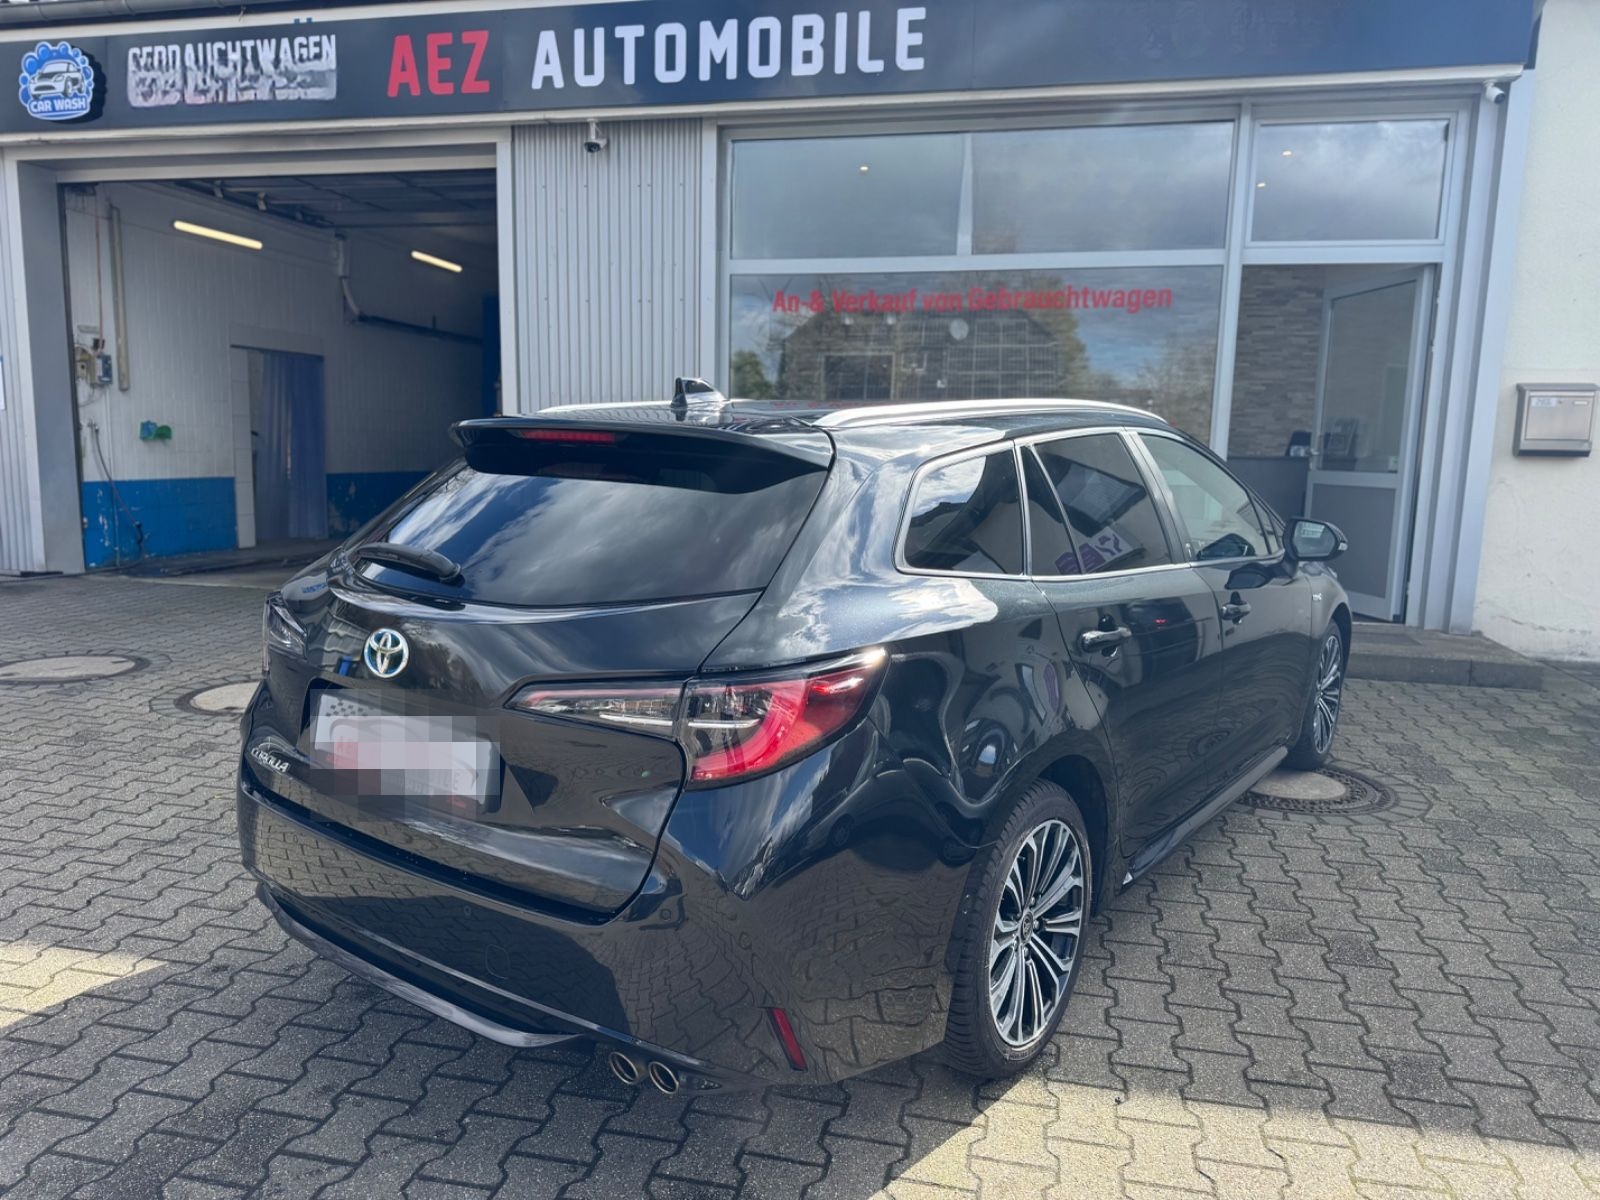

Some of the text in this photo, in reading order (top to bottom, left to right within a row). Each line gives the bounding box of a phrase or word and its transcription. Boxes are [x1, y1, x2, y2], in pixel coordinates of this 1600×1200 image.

[387, 30, 490, 98] AEZ
[531, 6, 926, 90] AUTOMOBILE
[30, 97, 86, 113] CAR WASH
[831, 287, 917, 313] Verkauf
[922, 291, 962, 313] von
[968, 284, 1173, 315] Gebrauchtwagen
